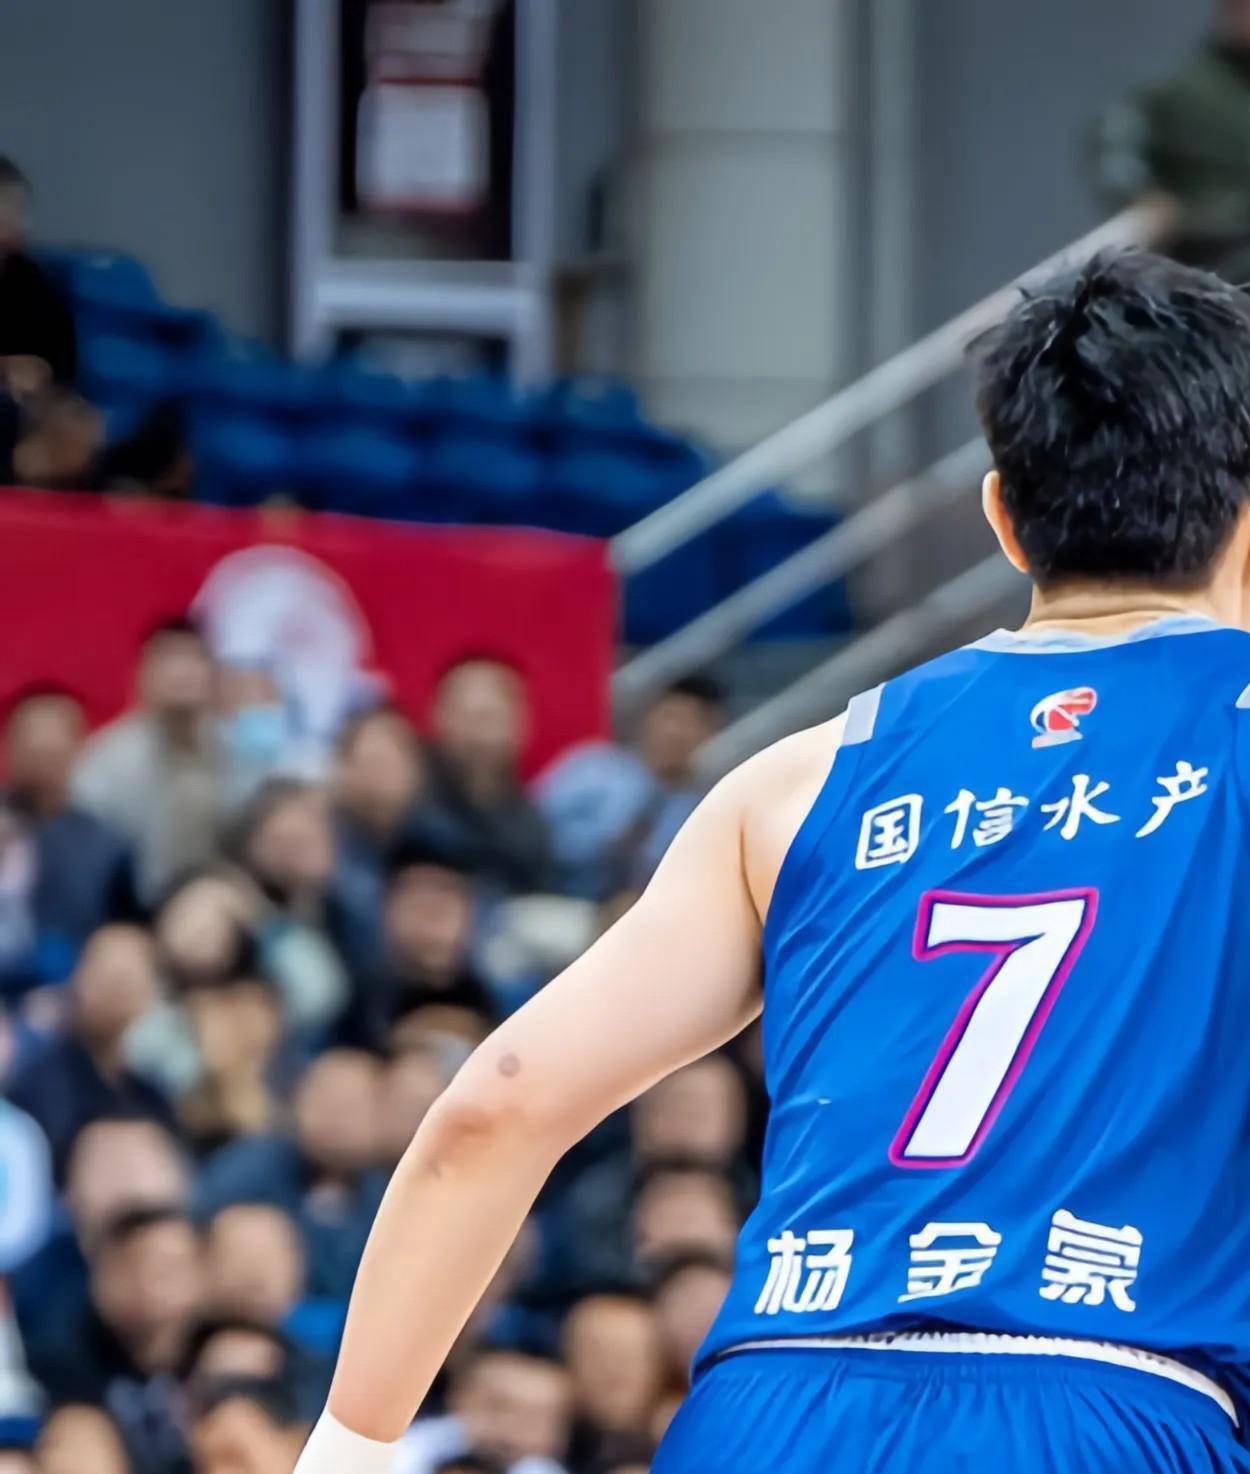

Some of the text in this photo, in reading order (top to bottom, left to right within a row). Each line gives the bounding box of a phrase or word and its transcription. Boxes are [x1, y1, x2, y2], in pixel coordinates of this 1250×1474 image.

[855, 760, 1208, 870] 国信水产
[888, 887, 1099, 1169] 7
[754, 1208, 1143, 1315] 杨金蒙
